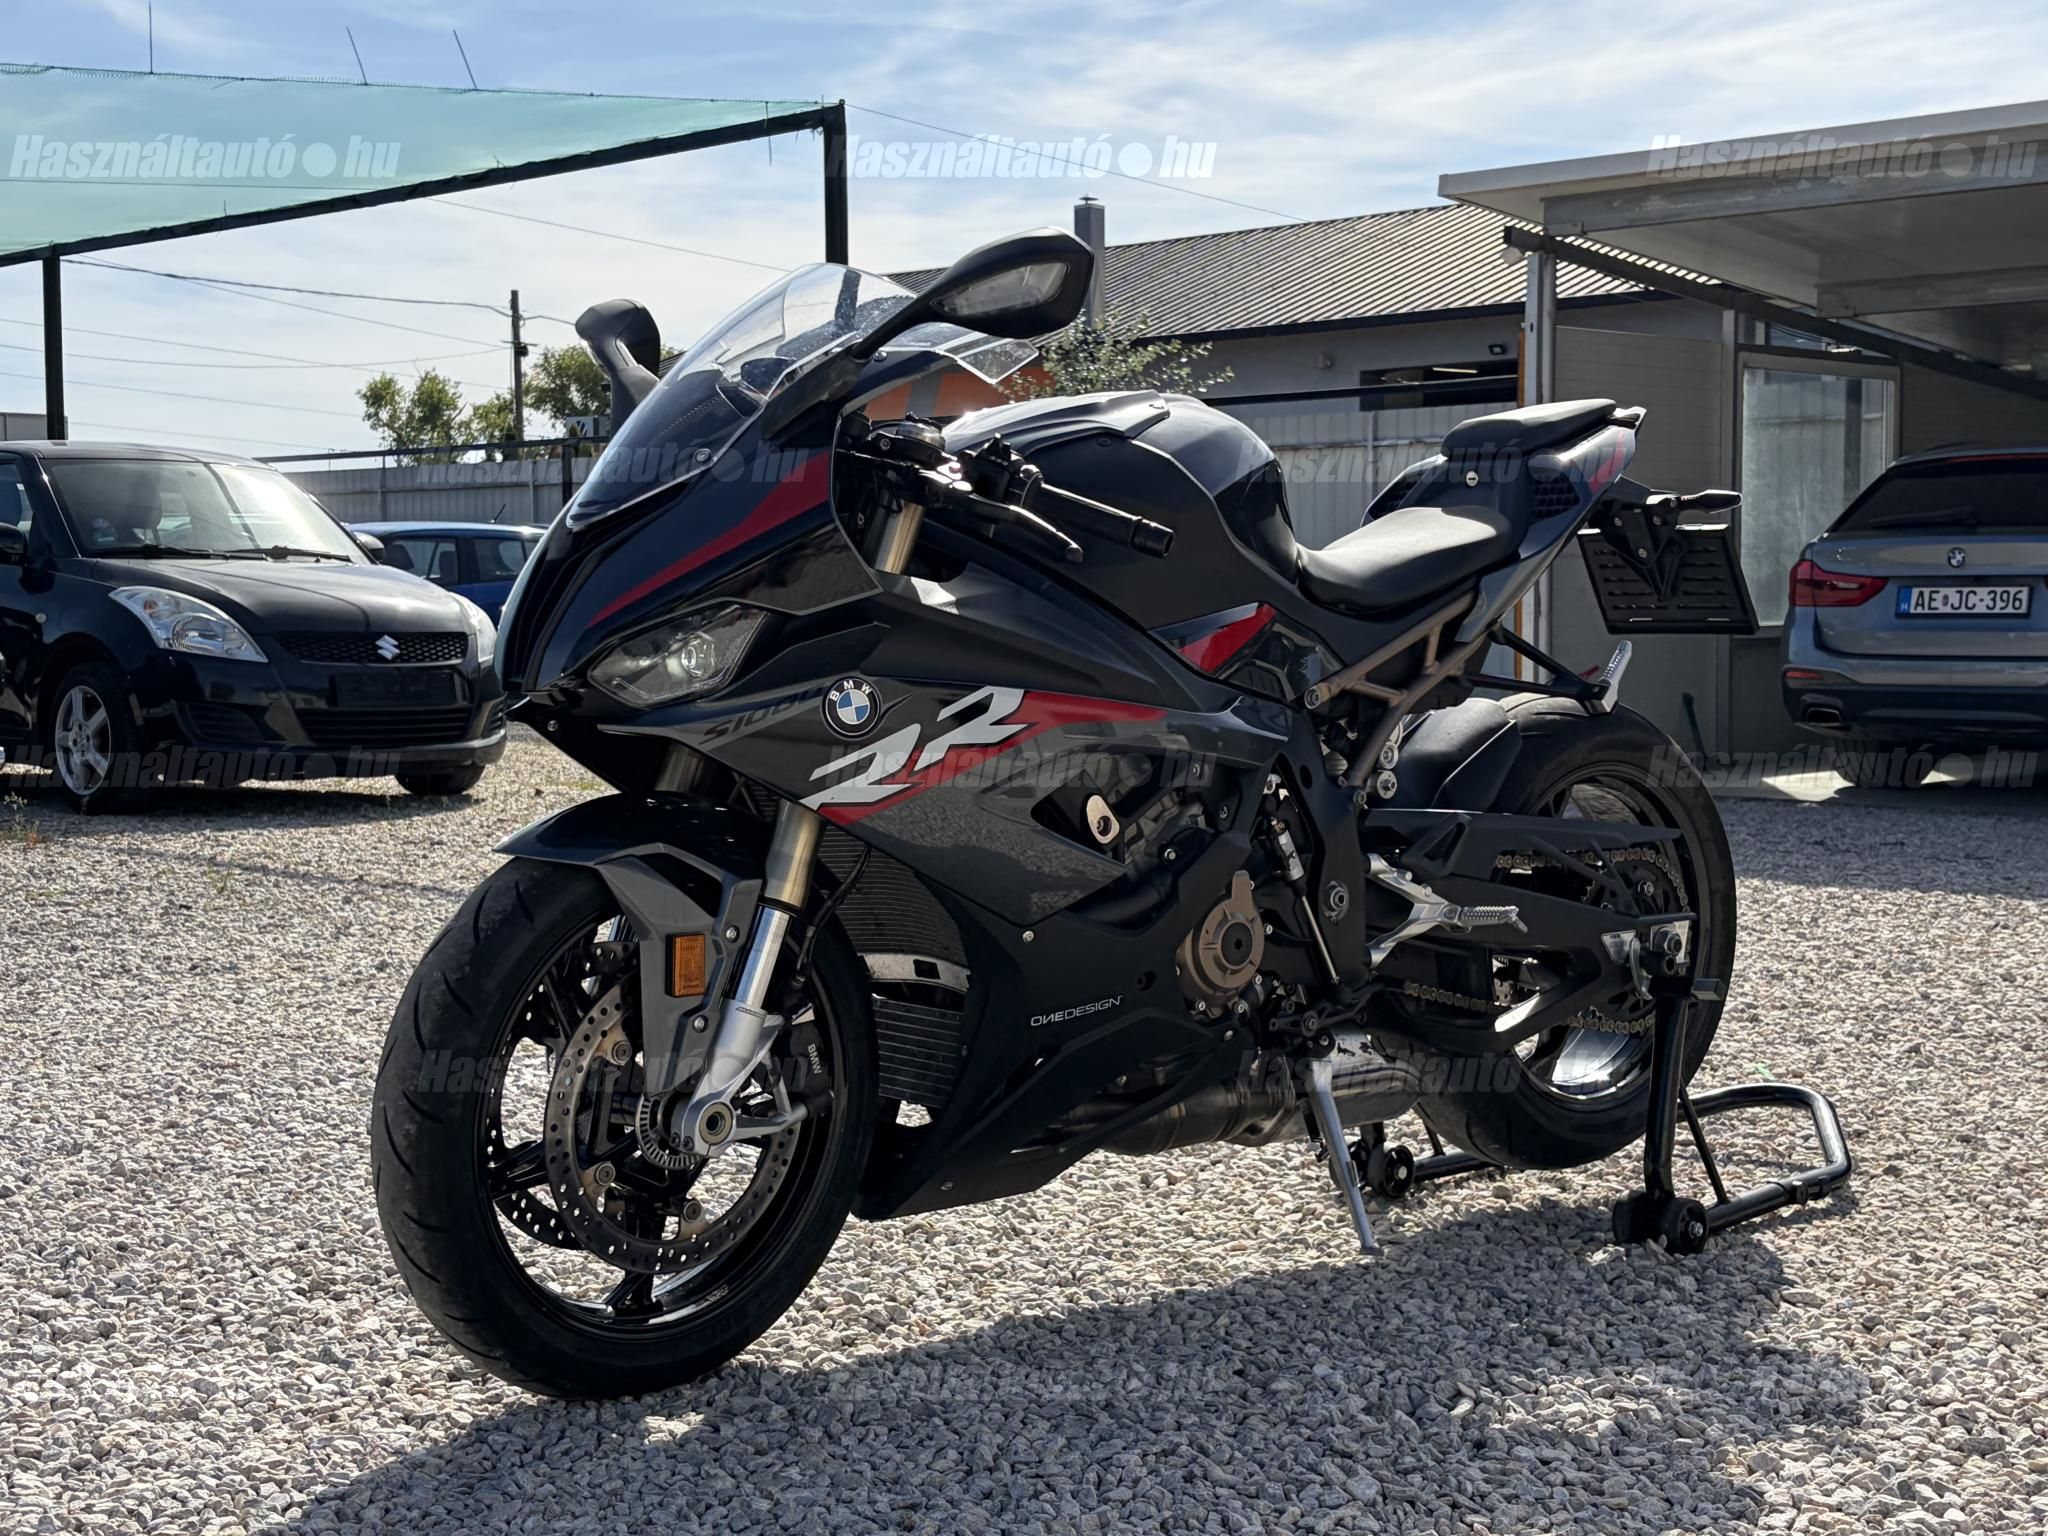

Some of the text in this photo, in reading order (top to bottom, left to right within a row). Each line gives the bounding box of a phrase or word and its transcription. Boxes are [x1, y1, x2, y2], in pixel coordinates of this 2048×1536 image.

[830, 680, 872, 702] BMW
[799, 685, 1030, 811] RR
[807, 1043, 822, 1075] BMW
